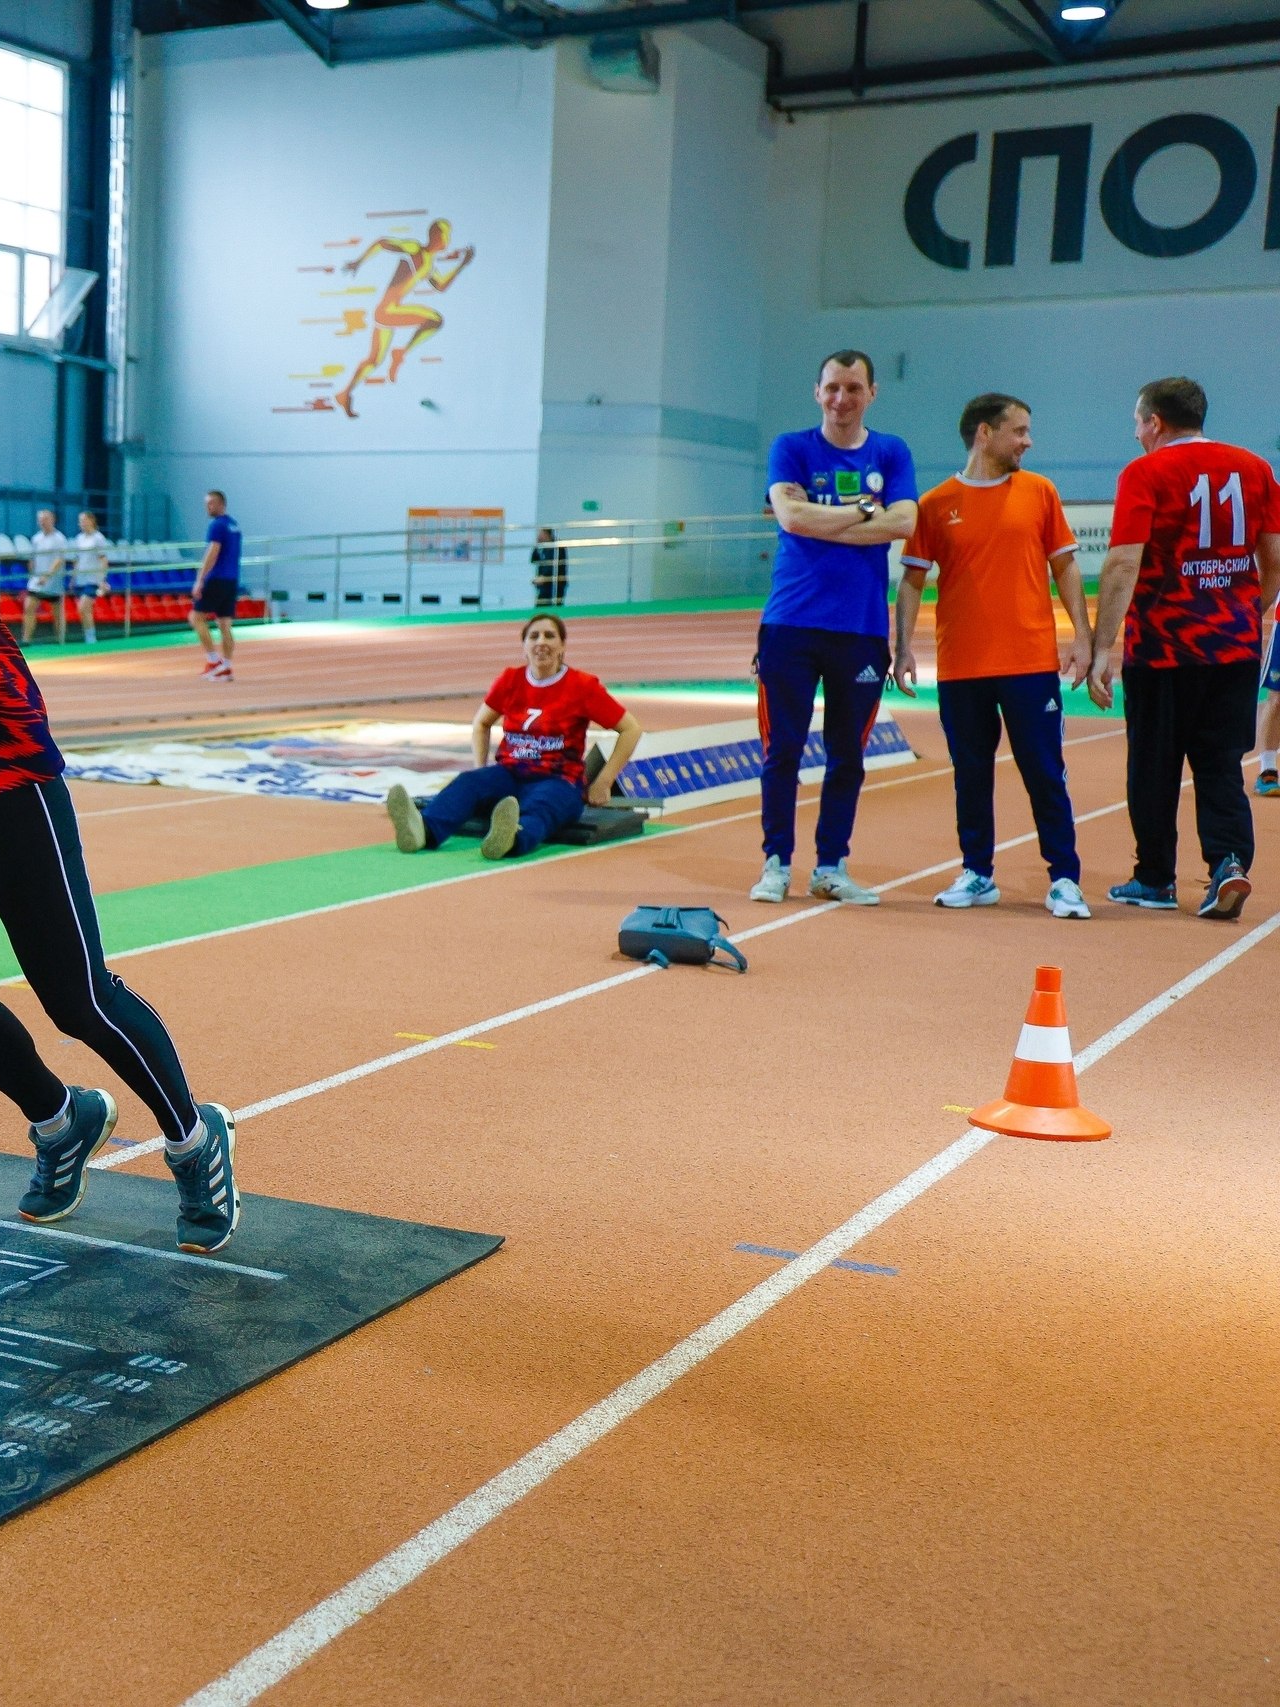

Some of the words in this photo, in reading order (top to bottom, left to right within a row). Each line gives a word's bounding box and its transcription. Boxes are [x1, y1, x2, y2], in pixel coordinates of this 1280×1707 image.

[903, 104, 1280, 271] СПО
[1189, 471, 1248, 549] 11
[1181, 554, 1251, 576] ОКТЯБРЬСКИЙ
[1199, 575, 1232, 590] РАЙОН
[522, 708, 543, 731] 7
[51, 1394, 111, 1415] 70
